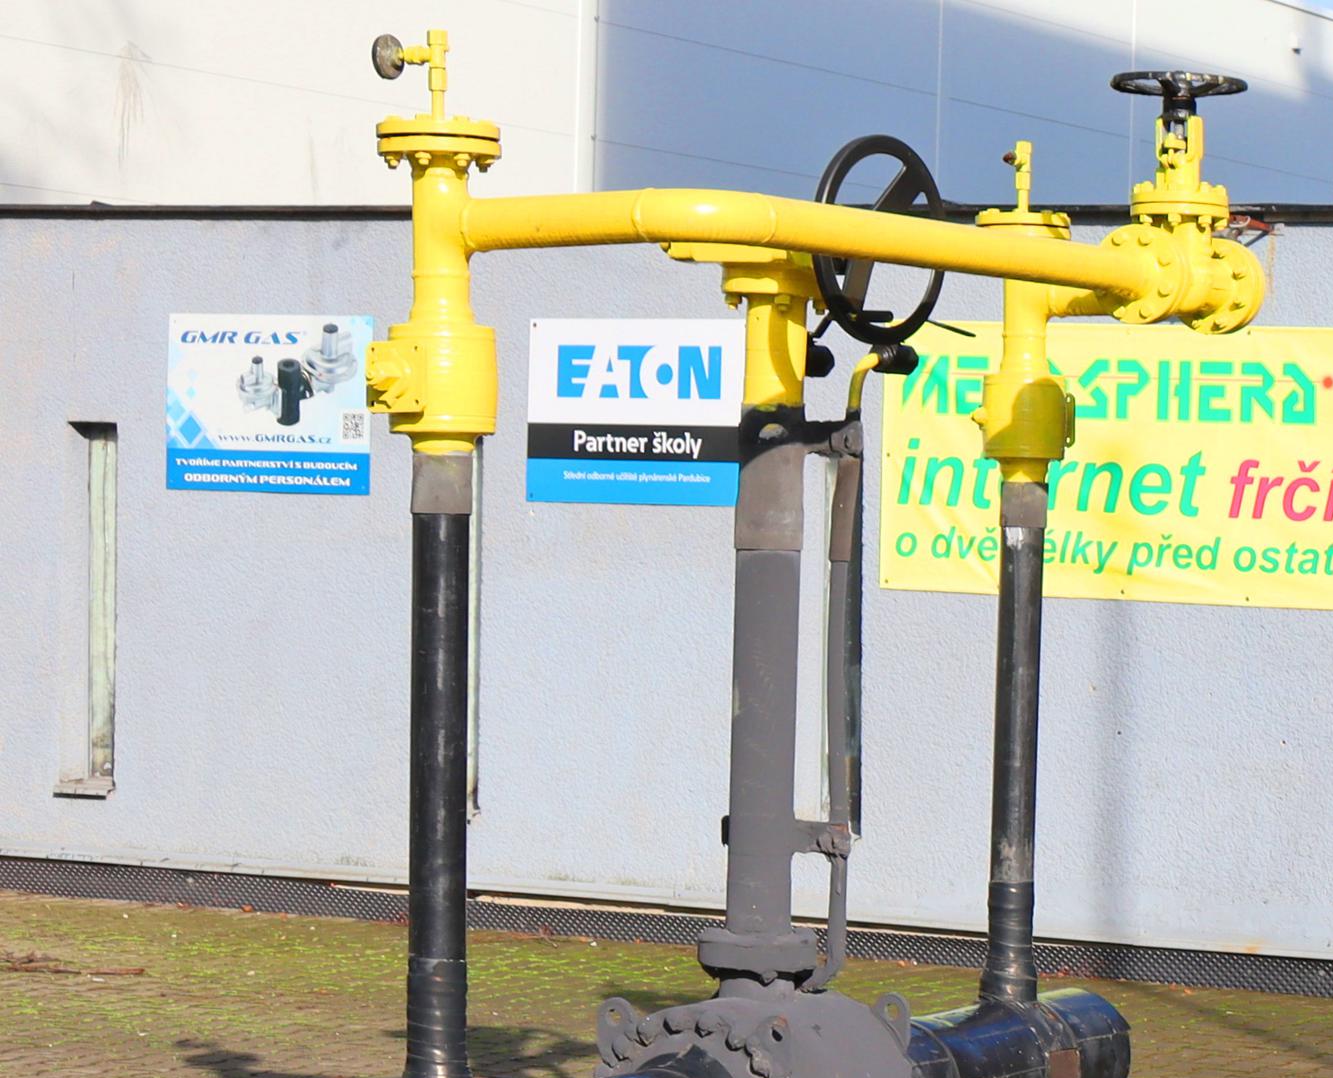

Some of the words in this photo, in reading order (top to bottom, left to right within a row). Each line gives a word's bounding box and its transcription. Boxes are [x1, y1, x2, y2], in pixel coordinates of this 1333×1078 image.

[181, 330, 238, 344] GMR
[244, 331, 301, 345] GAS
[557, 344, 722, 400] EATON
[574, 430, 647, 454] Partner
[652, 432, 702, 459] školy
[184, 472, 258, 484] ODBORNÝM
[260, 474, 350, 486] PERSONÁLEM
[222, 459, 293, 468] PARTNERSTVÍ
[303, 461, 357, 470] BUDOUCÍM
[897, 438, 1206, 517] intrnet
[896, 531, 918, 557] o
[1127, 534, 1221, 575] před
